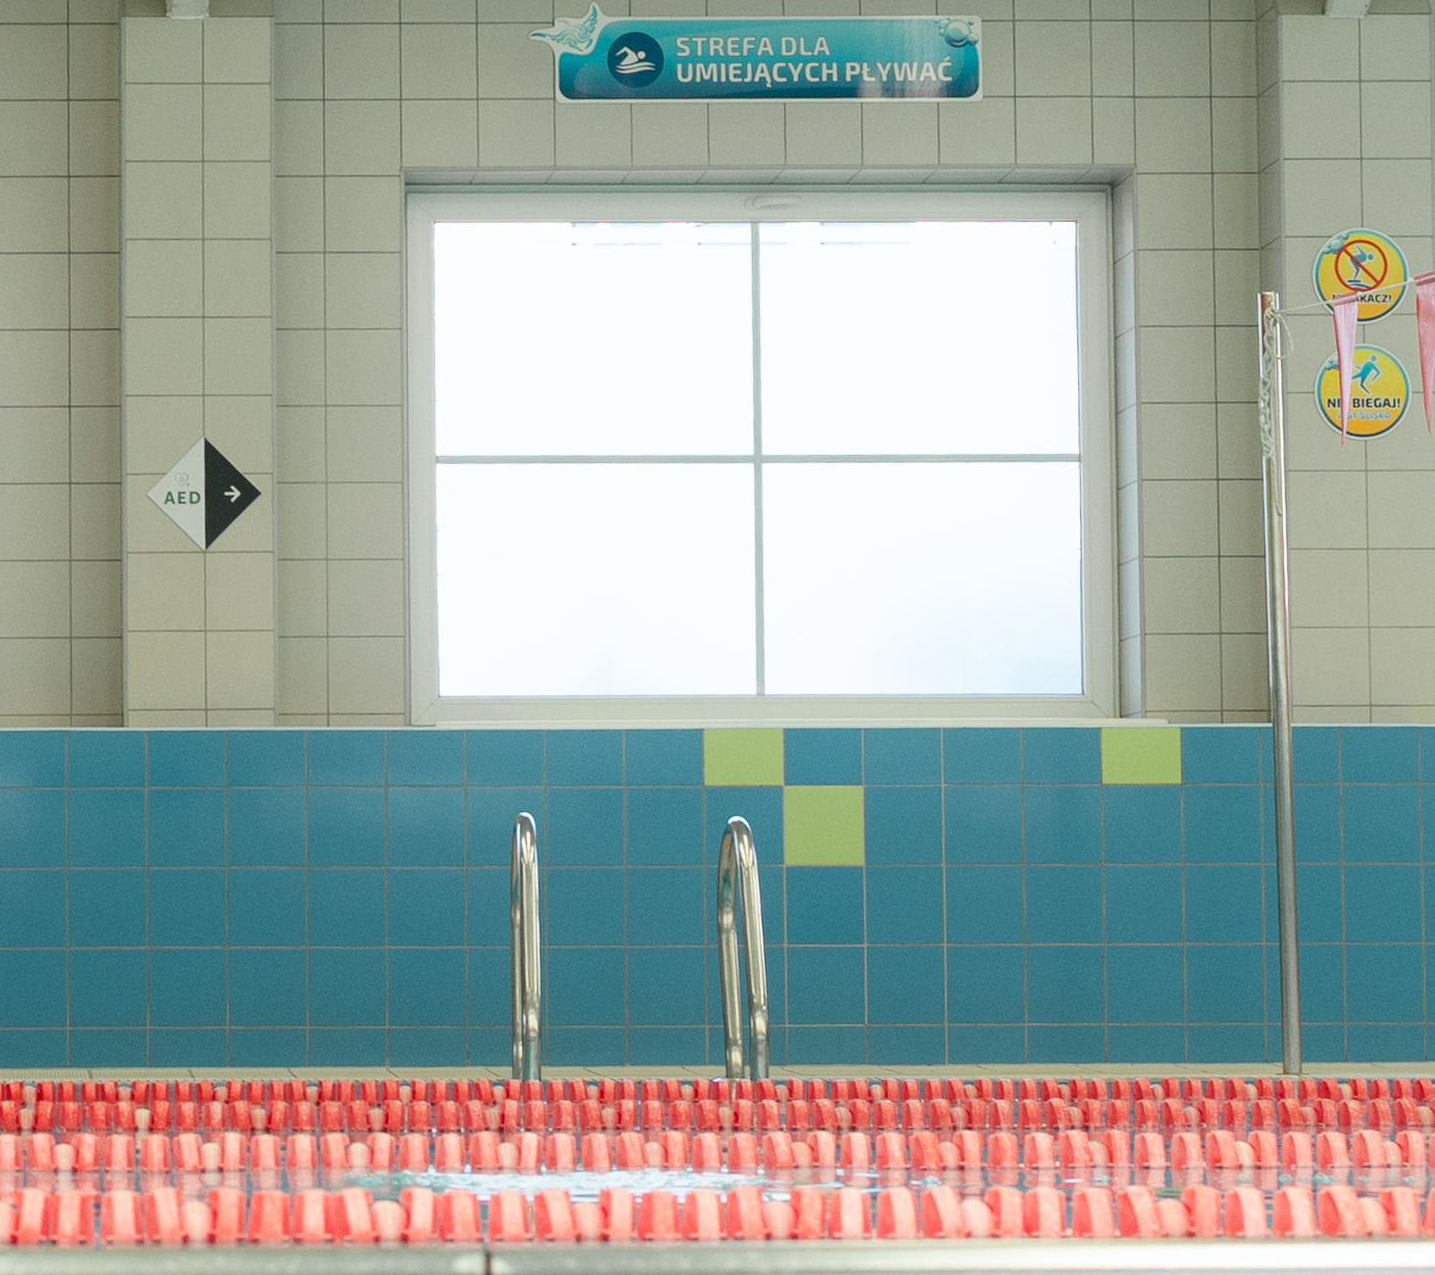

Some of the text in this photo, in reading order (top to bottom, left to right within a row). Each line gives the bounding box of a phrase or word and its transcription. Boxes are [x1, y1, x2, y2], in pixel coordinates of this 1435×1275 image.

[676, 36, 831, 57] STREFA DLA
[676, 56, 953, 87] UMIEJĄCYCH PŁYWAĆ
[1355, 293, 1392, 303] KACZ!
[1352, 397, 1401, 408] BIEGAJ!
[1359, 409, 1392, 420] ŚLISKO
[164, 491, 201, 505] AED
